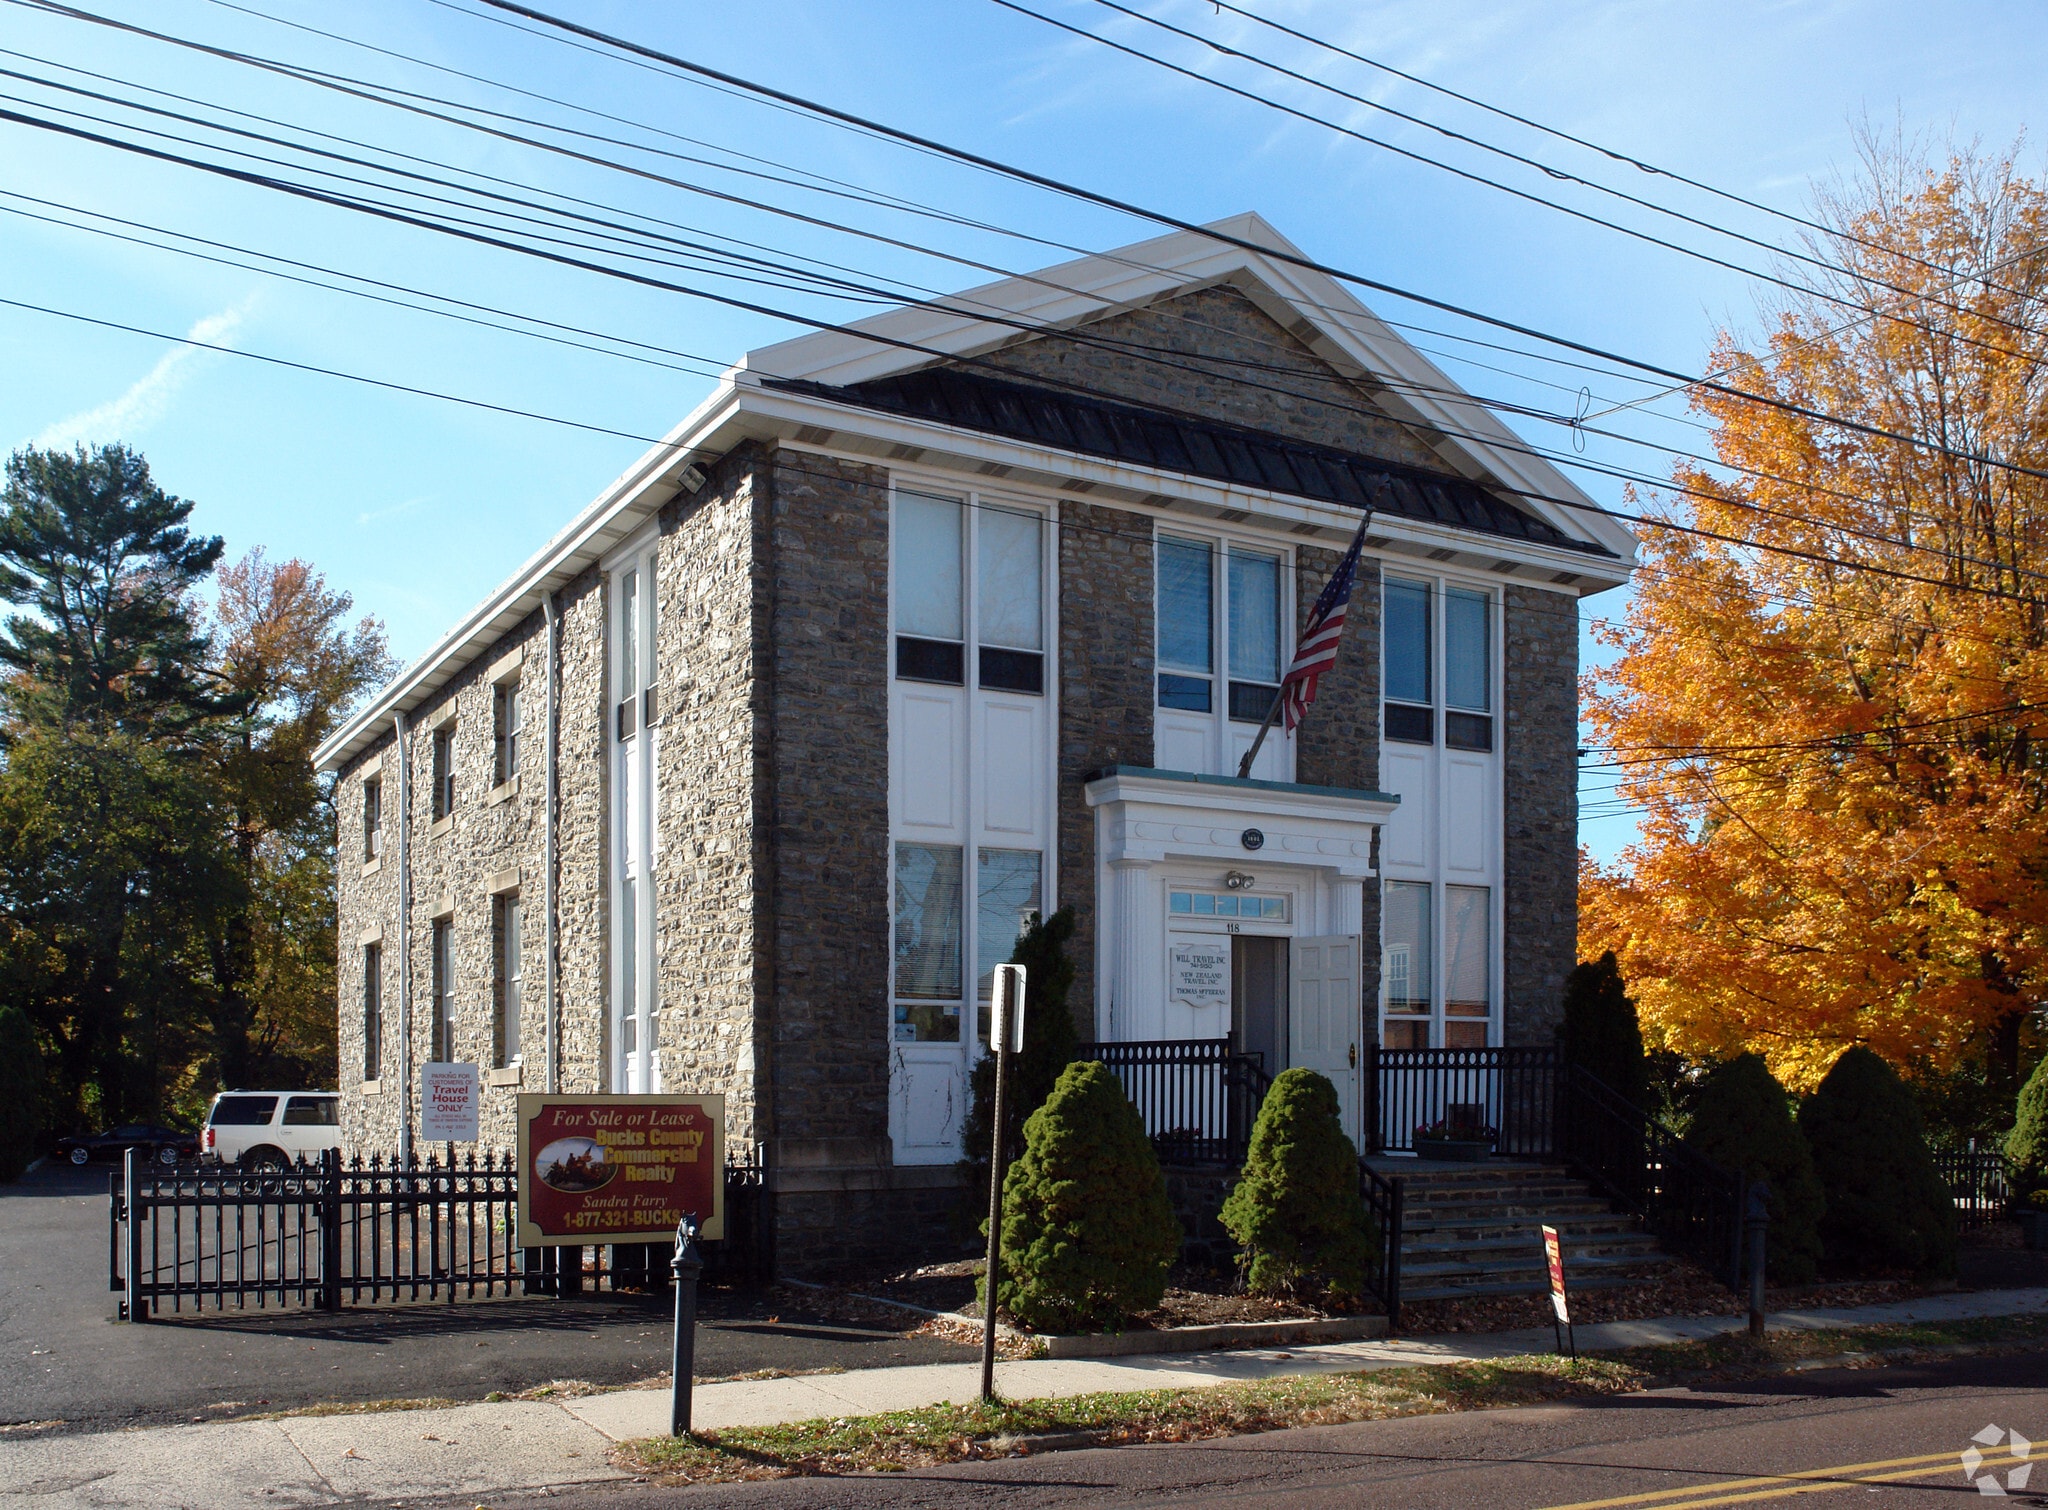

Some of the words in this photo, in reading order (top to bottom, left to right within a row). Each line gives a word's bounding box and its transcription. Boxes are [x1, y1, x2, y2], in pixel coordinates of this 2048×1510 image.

[1227, 923, 1240, 933] 118
[1176, 954, 1190, 963] WILL
[1193, 955, 1215, 963] TRAVEL
[433, 1085, 469, 1094] Travel
[432, 1094, 469, 1103] House
[437, 1104, 464, 1112] ONLY
[552, 1110, 583, 1126] For
[587, 1110, 622, 1126] Sale
[627, 1113, 645, 1126] or
[649, 1110, 694, 1126] Lease
[596, 1128, 646, 1146] Bucks
[650, 1128, 704, 1148] County
[603, 1147, 698, 1164] Commercial
[625, 1165, 676, 1183] Realty
[582, 1195, 628, 1208] Sandra
[632, 1194, 668, 1209] Farry
[563, 1209, 681, 1228] 1-877-321-BUCKS
